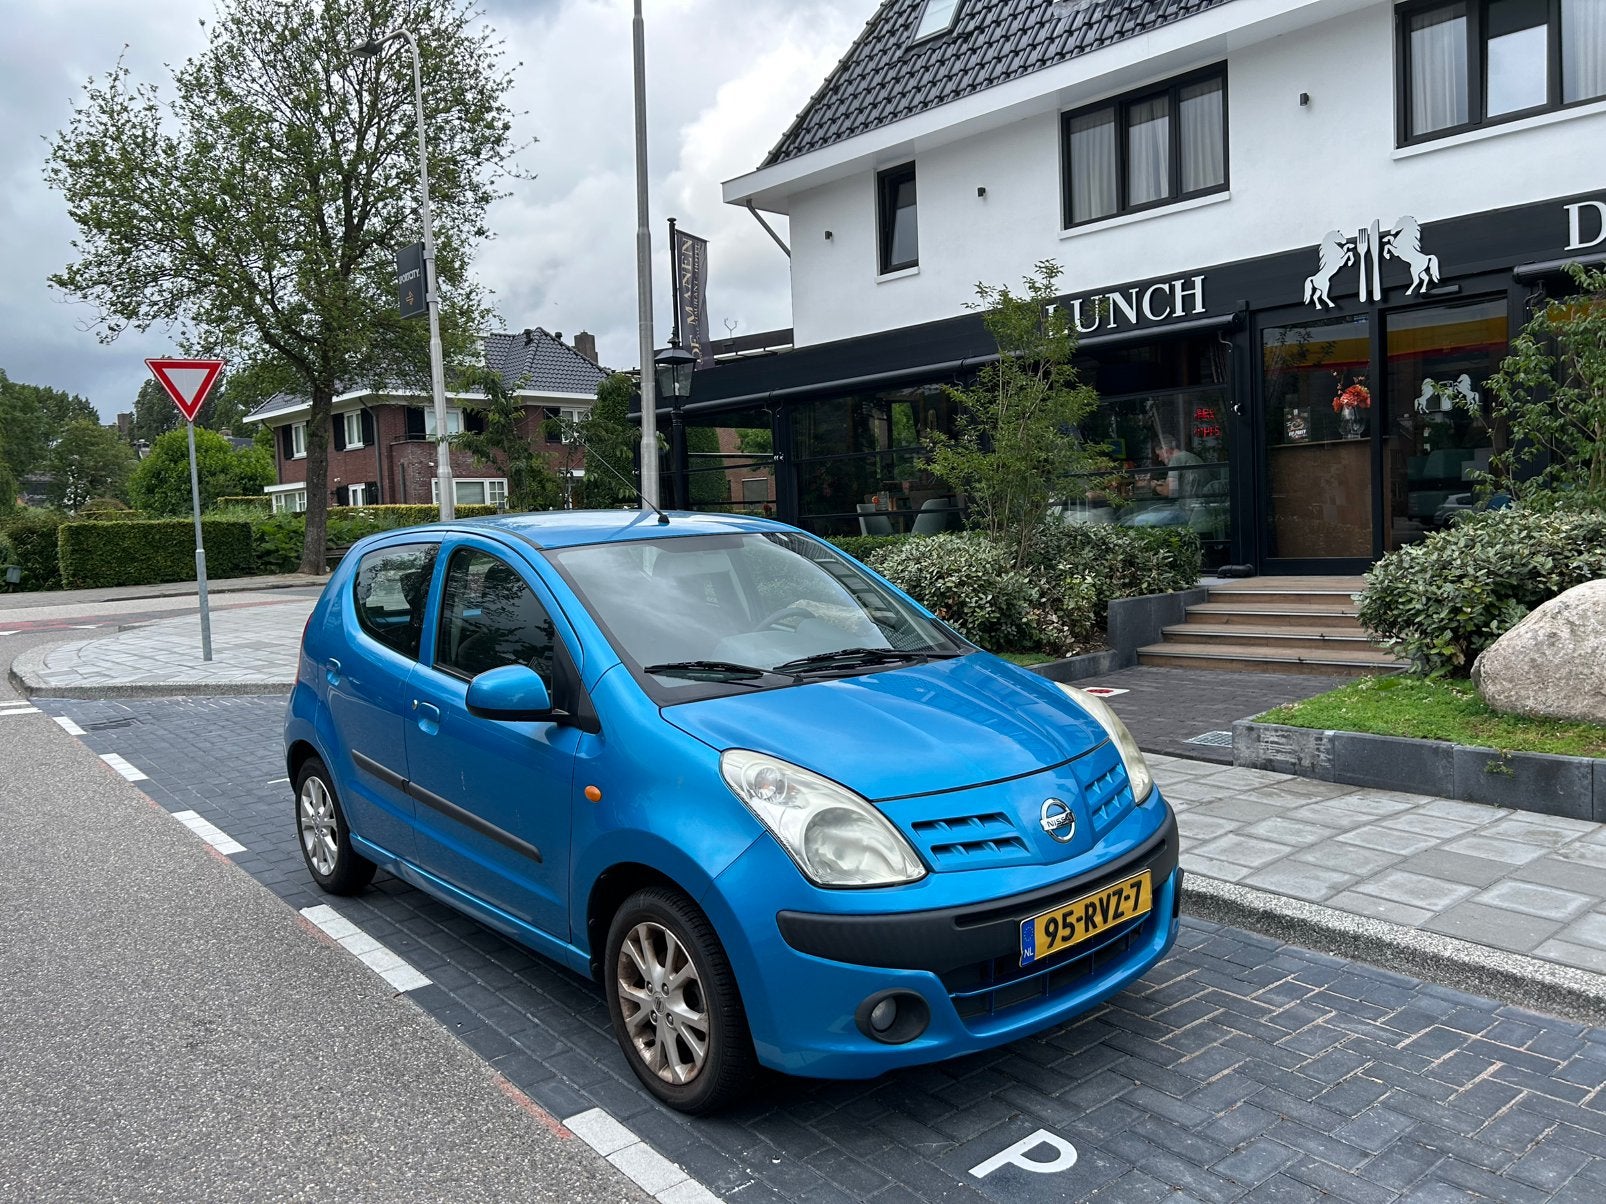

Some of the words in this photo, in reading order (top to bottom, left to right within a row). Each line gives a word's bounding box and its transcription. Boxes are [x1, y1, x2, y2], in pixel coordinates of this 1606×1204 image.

[681, 238, 697, 325] MANEN
[1045, 275, 1206, 339] LUNCH
[1044, 879, 1142, 949] 95-RVZ-7
[1024, 947, 1034, 958] NL
[968, 1128, 1078, 1179] P
